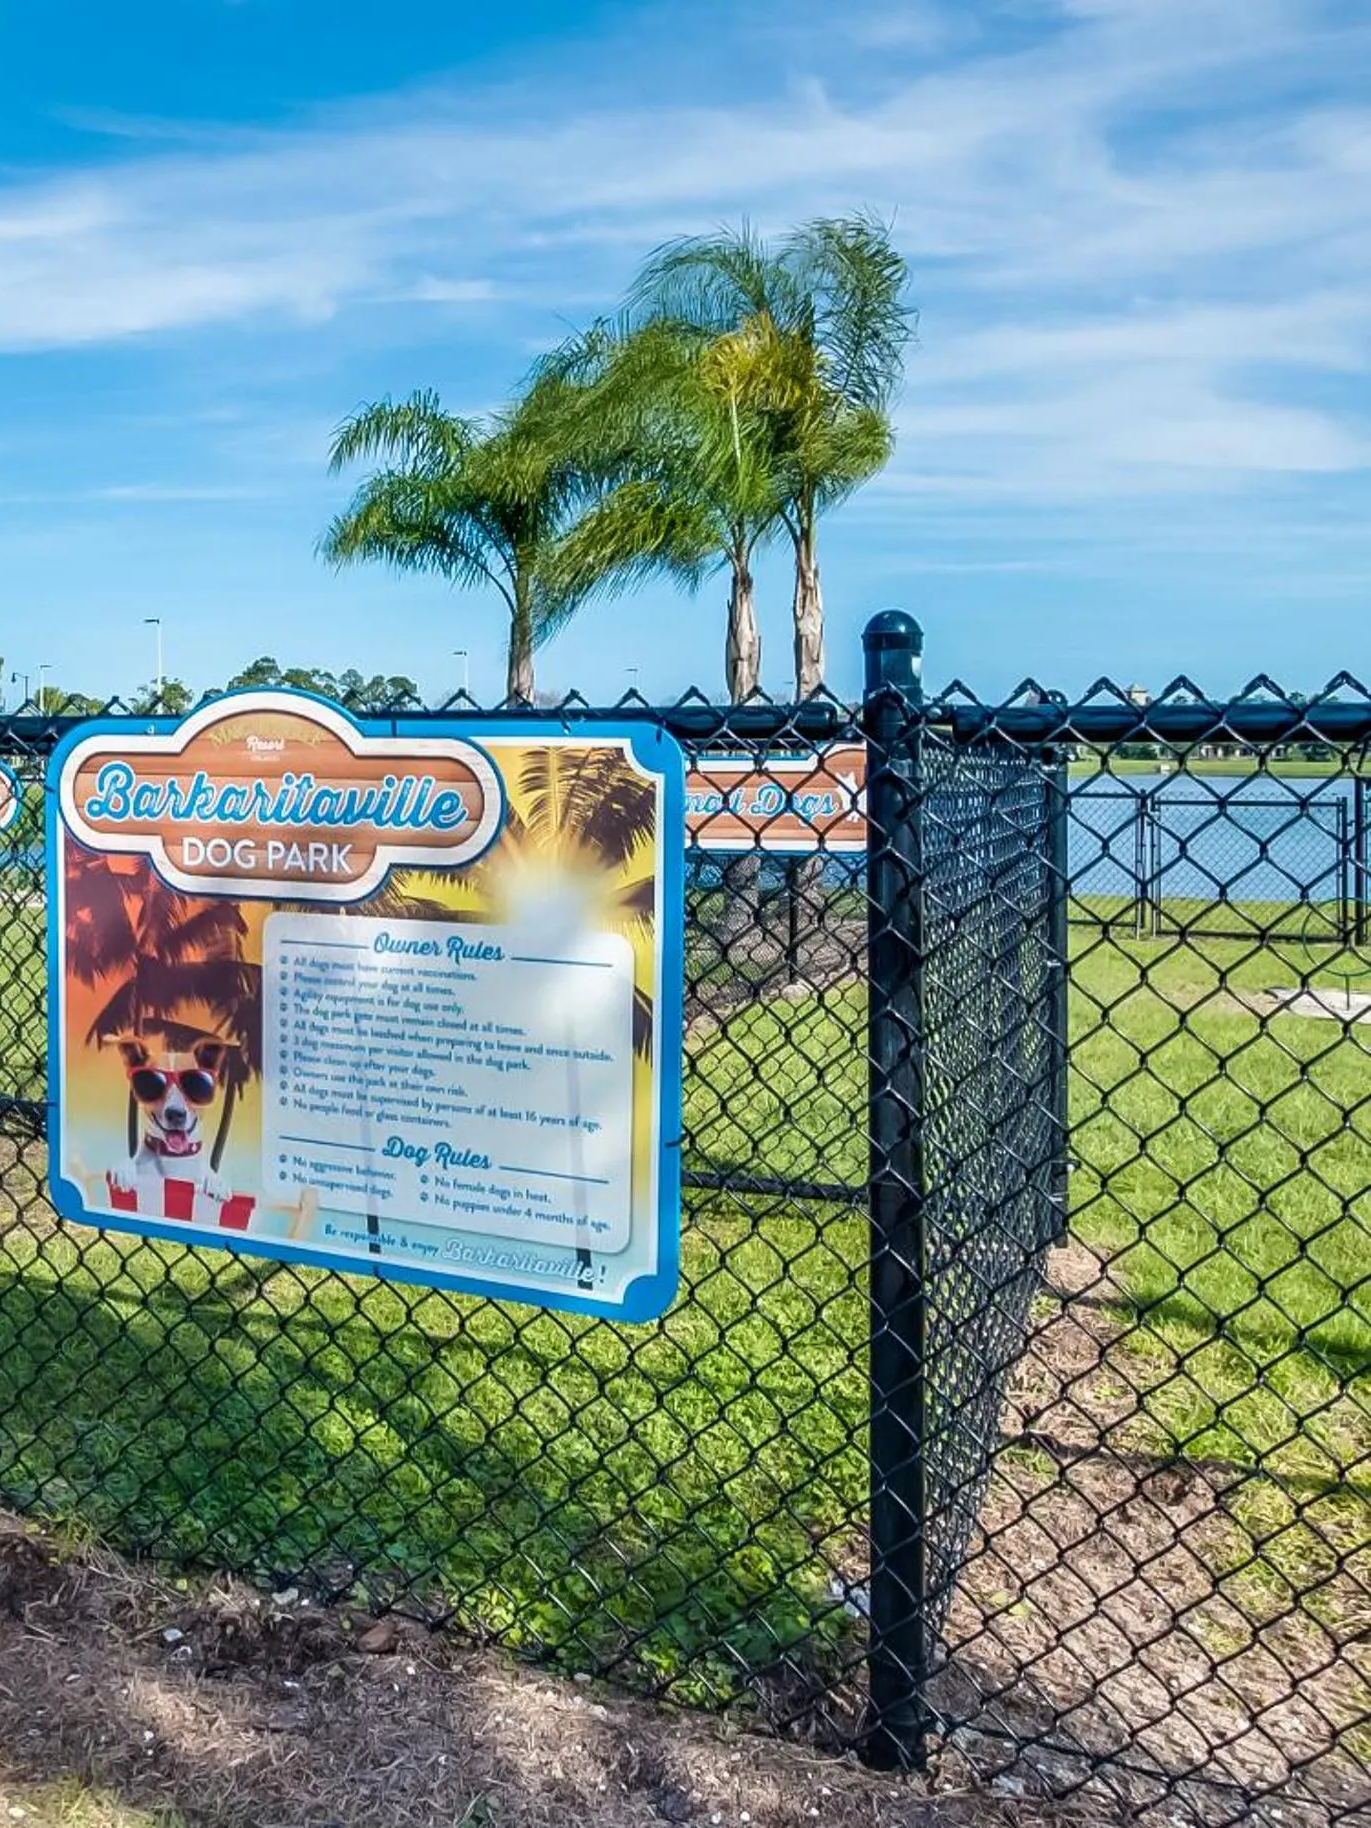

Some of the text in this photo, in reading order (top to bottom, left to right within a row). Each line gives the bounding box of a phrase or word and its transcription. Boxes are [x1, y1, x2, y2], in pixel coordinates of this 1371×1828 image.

[85, 762, 468, 831] Barkaritaville
[182, 838, 353, 875] DOG PARK
[374, 932, 505, 965] Owner Rules
[382, 1135, 492, 1170] Dog Rules
[325, 1223, 337, 1235] Be
[340, 1228, 396, 1246] responsible
[411, 1240, 439, 1256] enjoy
